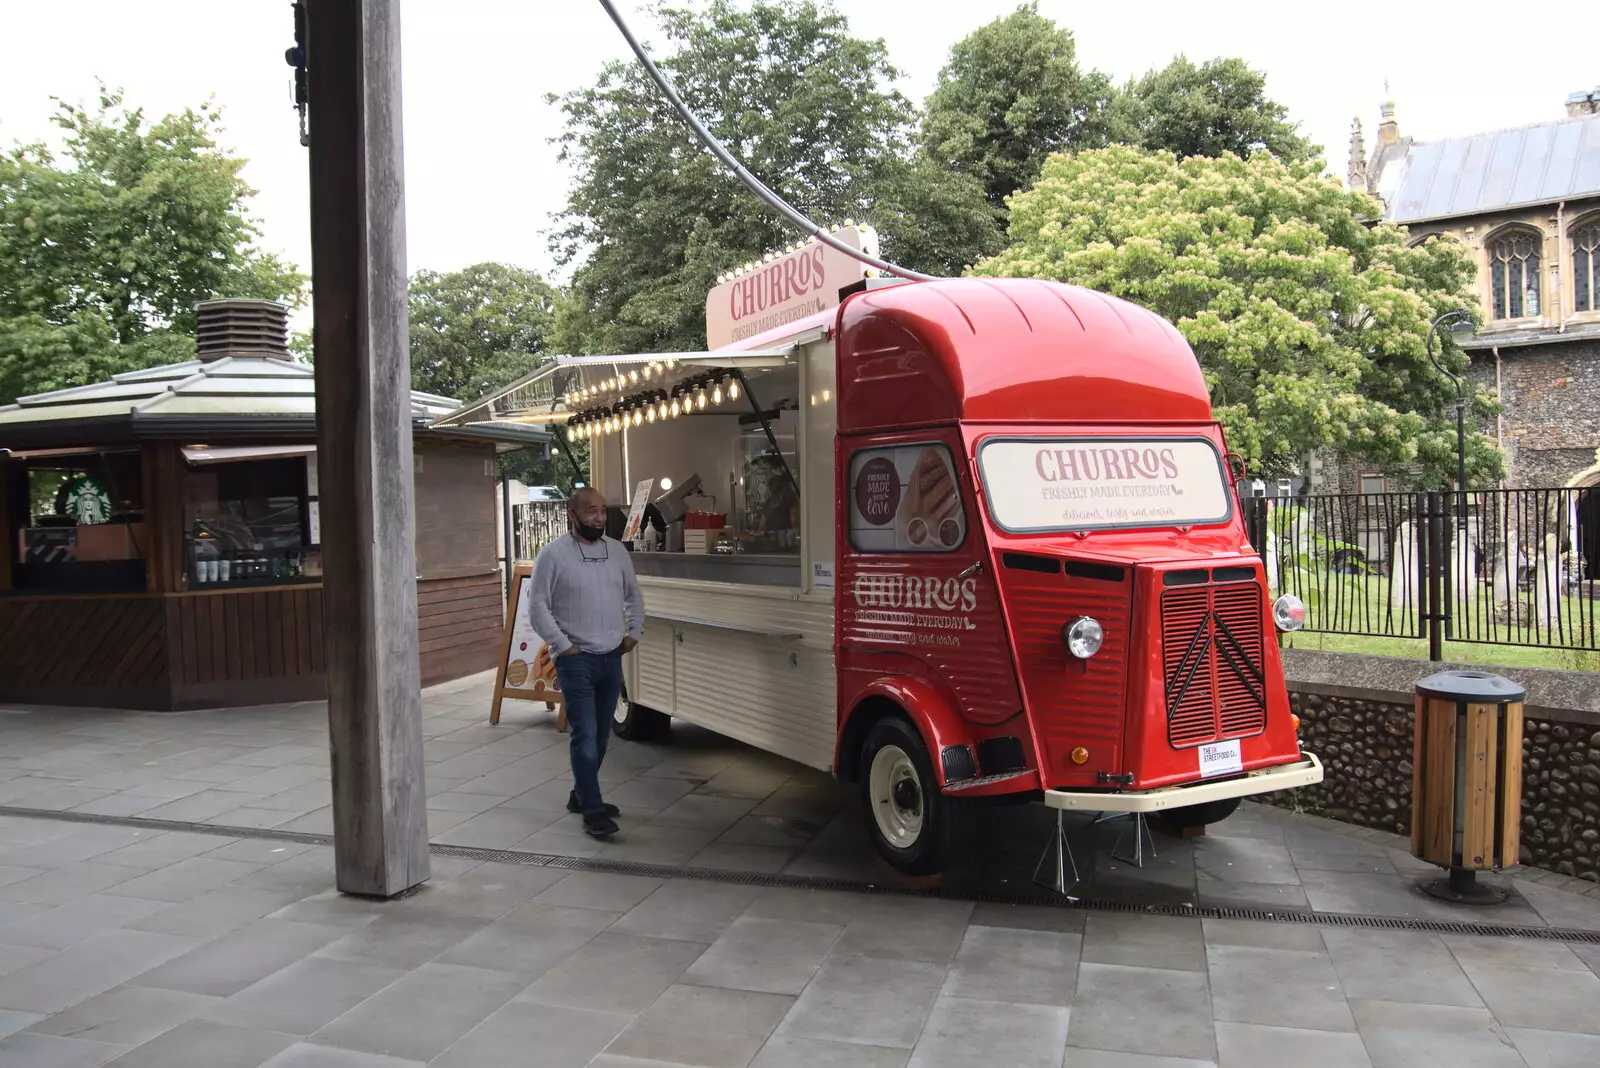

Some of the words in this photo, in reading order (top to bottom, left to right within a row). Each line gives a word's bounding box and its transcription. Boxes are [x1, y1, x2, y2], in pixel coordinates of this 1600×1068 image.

[731, 245, 824, 320] CHURROS
[731, 322, 758, 343] FRESHLY
[758, 313, 779, 333] MADE
[779, 300, 817, 325] EVERYDAY
[1035, 448, 1179, 482] CHURROS
[867, 481, 890, 493] MADE
[1041, 486, 1088, 500] FRESHLY
[1090, 485, 1122, 499] MADE
[1122, 484, 1172, 498] EVERYDAY
[867, 497, 890, 515] love
[1130, 508, 1146, 517] and
[854, 575, 977, 613] CHURROS
[916, 615, 964, 630] EVERYDAY
[918, 633, 934, 644] and
[1204, 751, 1229, 762] STREETFOOD
